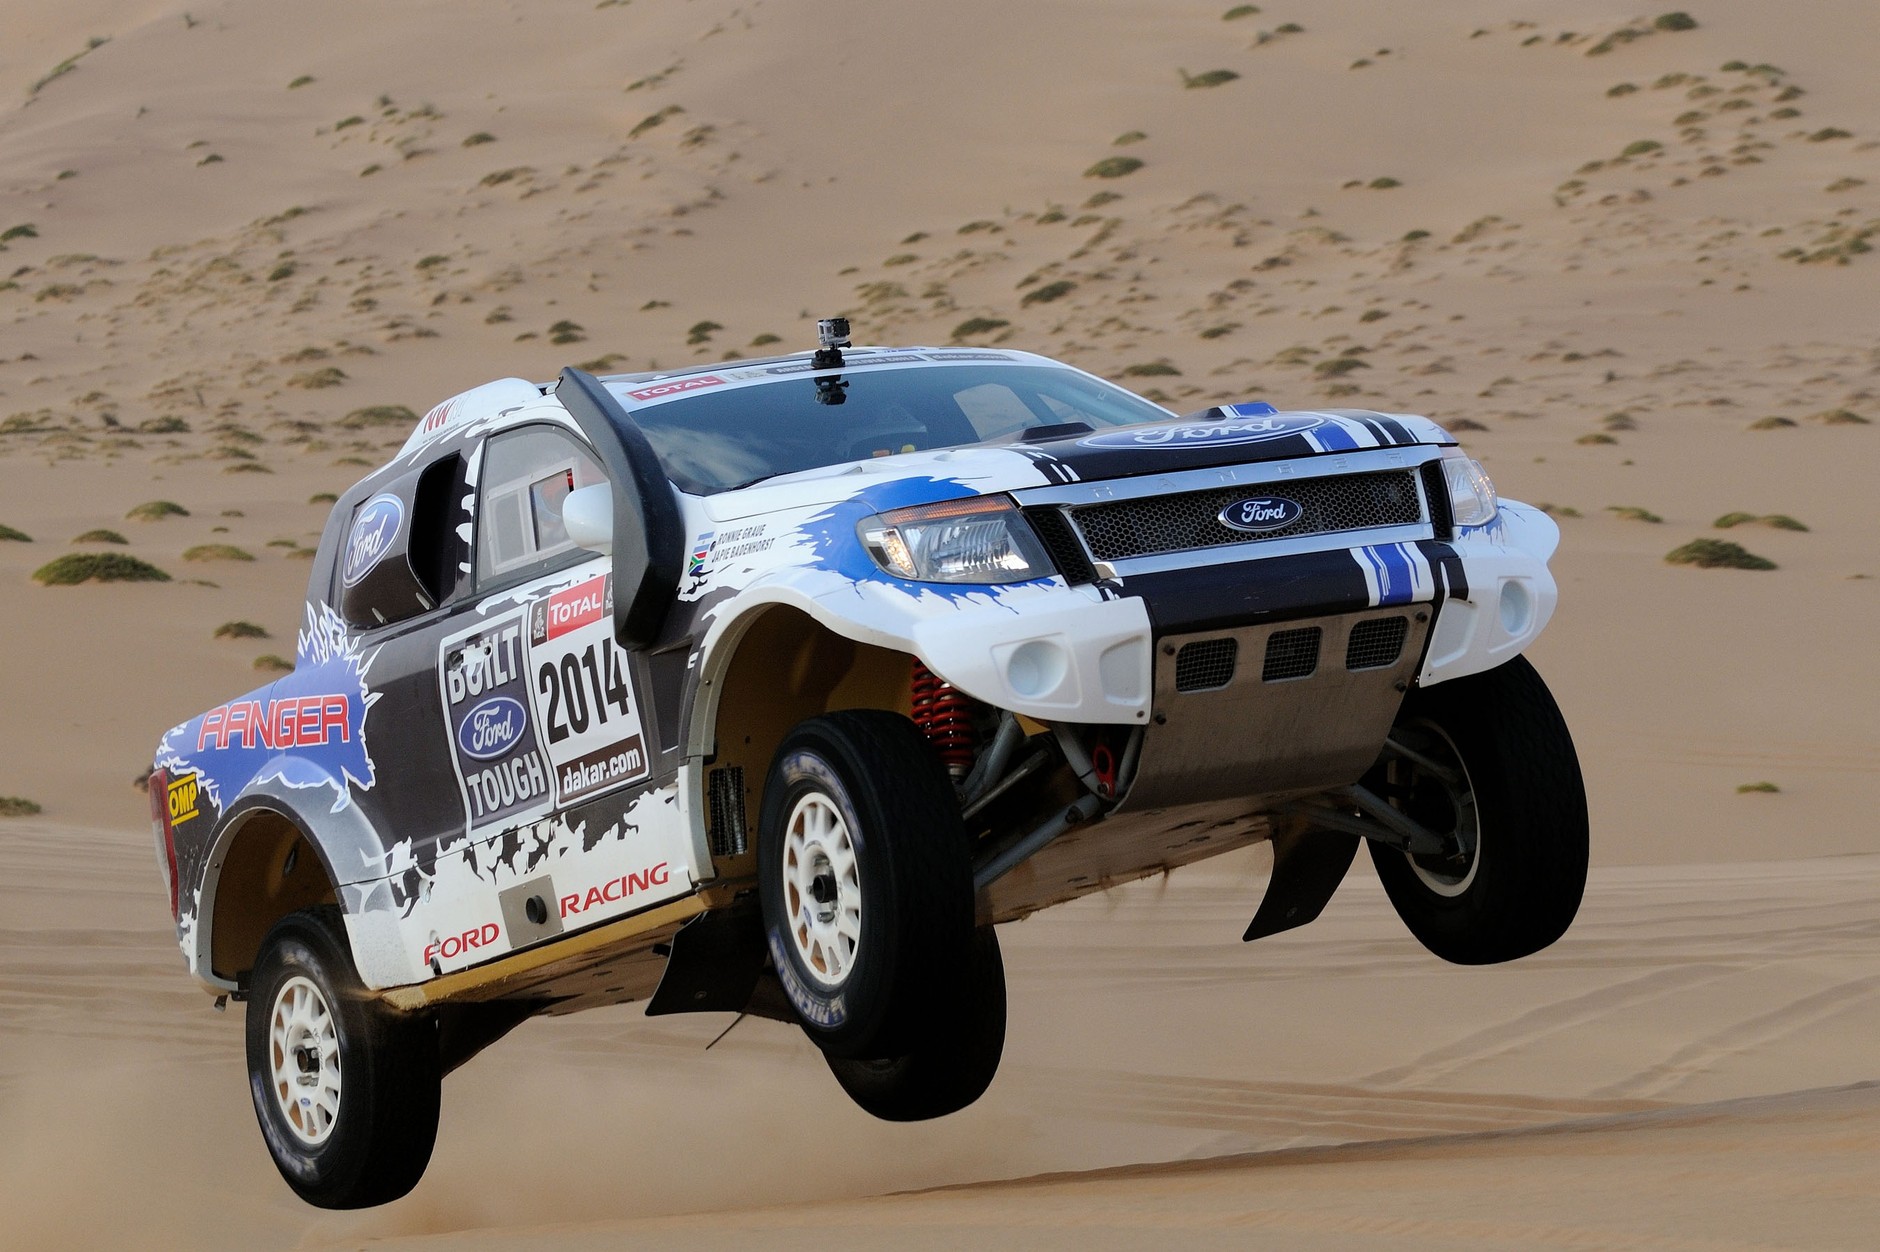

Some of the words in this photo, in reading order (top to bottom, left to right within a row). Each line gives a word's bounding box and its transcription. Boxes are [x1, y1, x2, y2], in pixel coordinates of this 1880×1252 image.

[633, 378, 719, 399] TOTAL
[1133, 419, 1286, 444] Ford
[717, 528, 743, 545] RONNIE
[742, 523, 766, 540] GRAUE
[1240, 500, 1287, 523] Ford
[347, 508, 389, 577] Ford
[711, 547, 731, 563] JAPIE
[730, 537, 775, 558] BADENHORST
[550, 592, 602, 626] TOTAL
[448, 624, 519, 705] BUILT
[538, 637, 630, 746] 2014
[197, 693, 350, 753] RANGER
[472, 705, 514, 752] Ford
[466, 751, 547, 808] TOUGH
[563, 747, 642, 795] dakar.com
[168, 781, 198, 818] OMP
[560, 862, 670, 919] RACING
[423, 922, 500, 966] FORD
